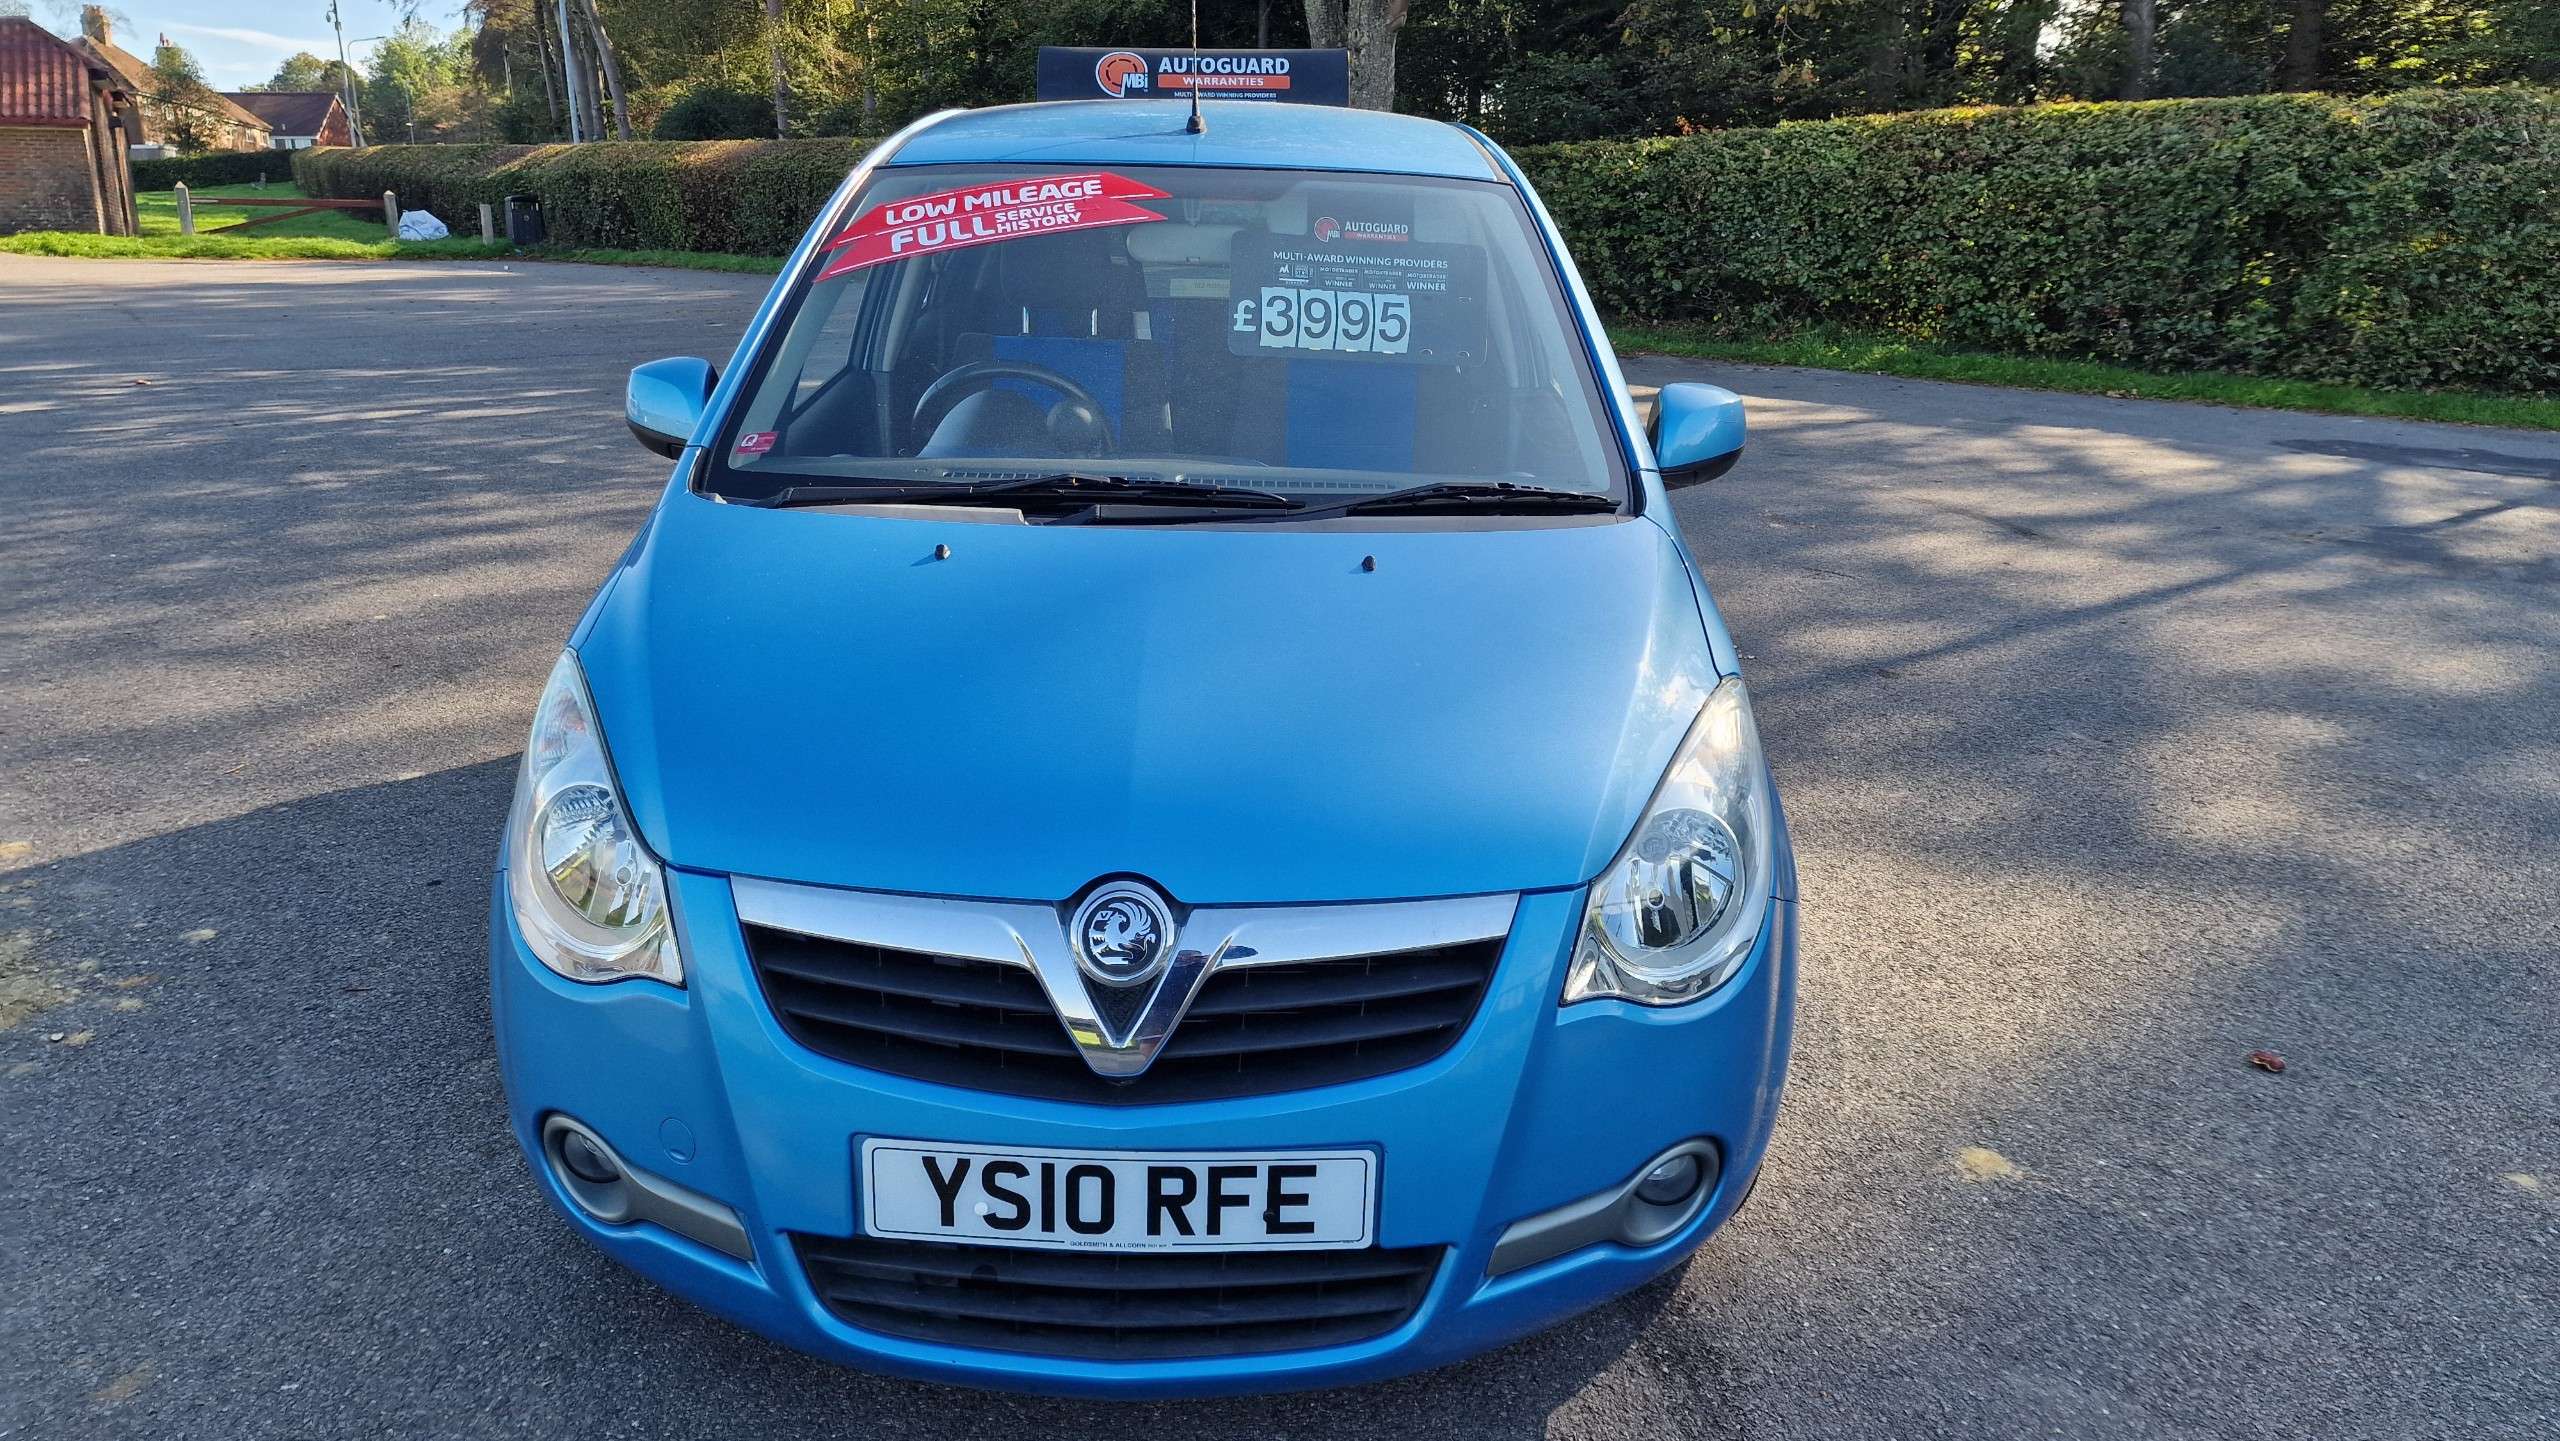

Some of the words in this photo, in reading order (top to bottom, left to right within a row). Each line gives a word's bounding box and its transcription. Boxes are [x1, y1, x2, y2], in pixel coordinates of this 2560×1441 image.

[1158, 57, 1290, 74] AUTOGUARD
[1182, 76, 1264, 87] WARRANTIES
[886, 197, 957, 226] LOW
[964, 179, 1104, 212] MILEAGE
[995, 203, 1076, 222] SERVICE
[996, 212, 1082, 233] HISTORY
[1344, 221, 1409, 234] AUTOGUARD
[890, 216, 995, 253] FULL
[1345, 255, 1392, 266] WINNING
[1393, 258, 1449, 269] PROVIDERS
[1406, 281, 1447, 291] WINNER
[921, 1155, 1115, 1236] YS10
[1146, 1164, 1318, 1236] RFE
